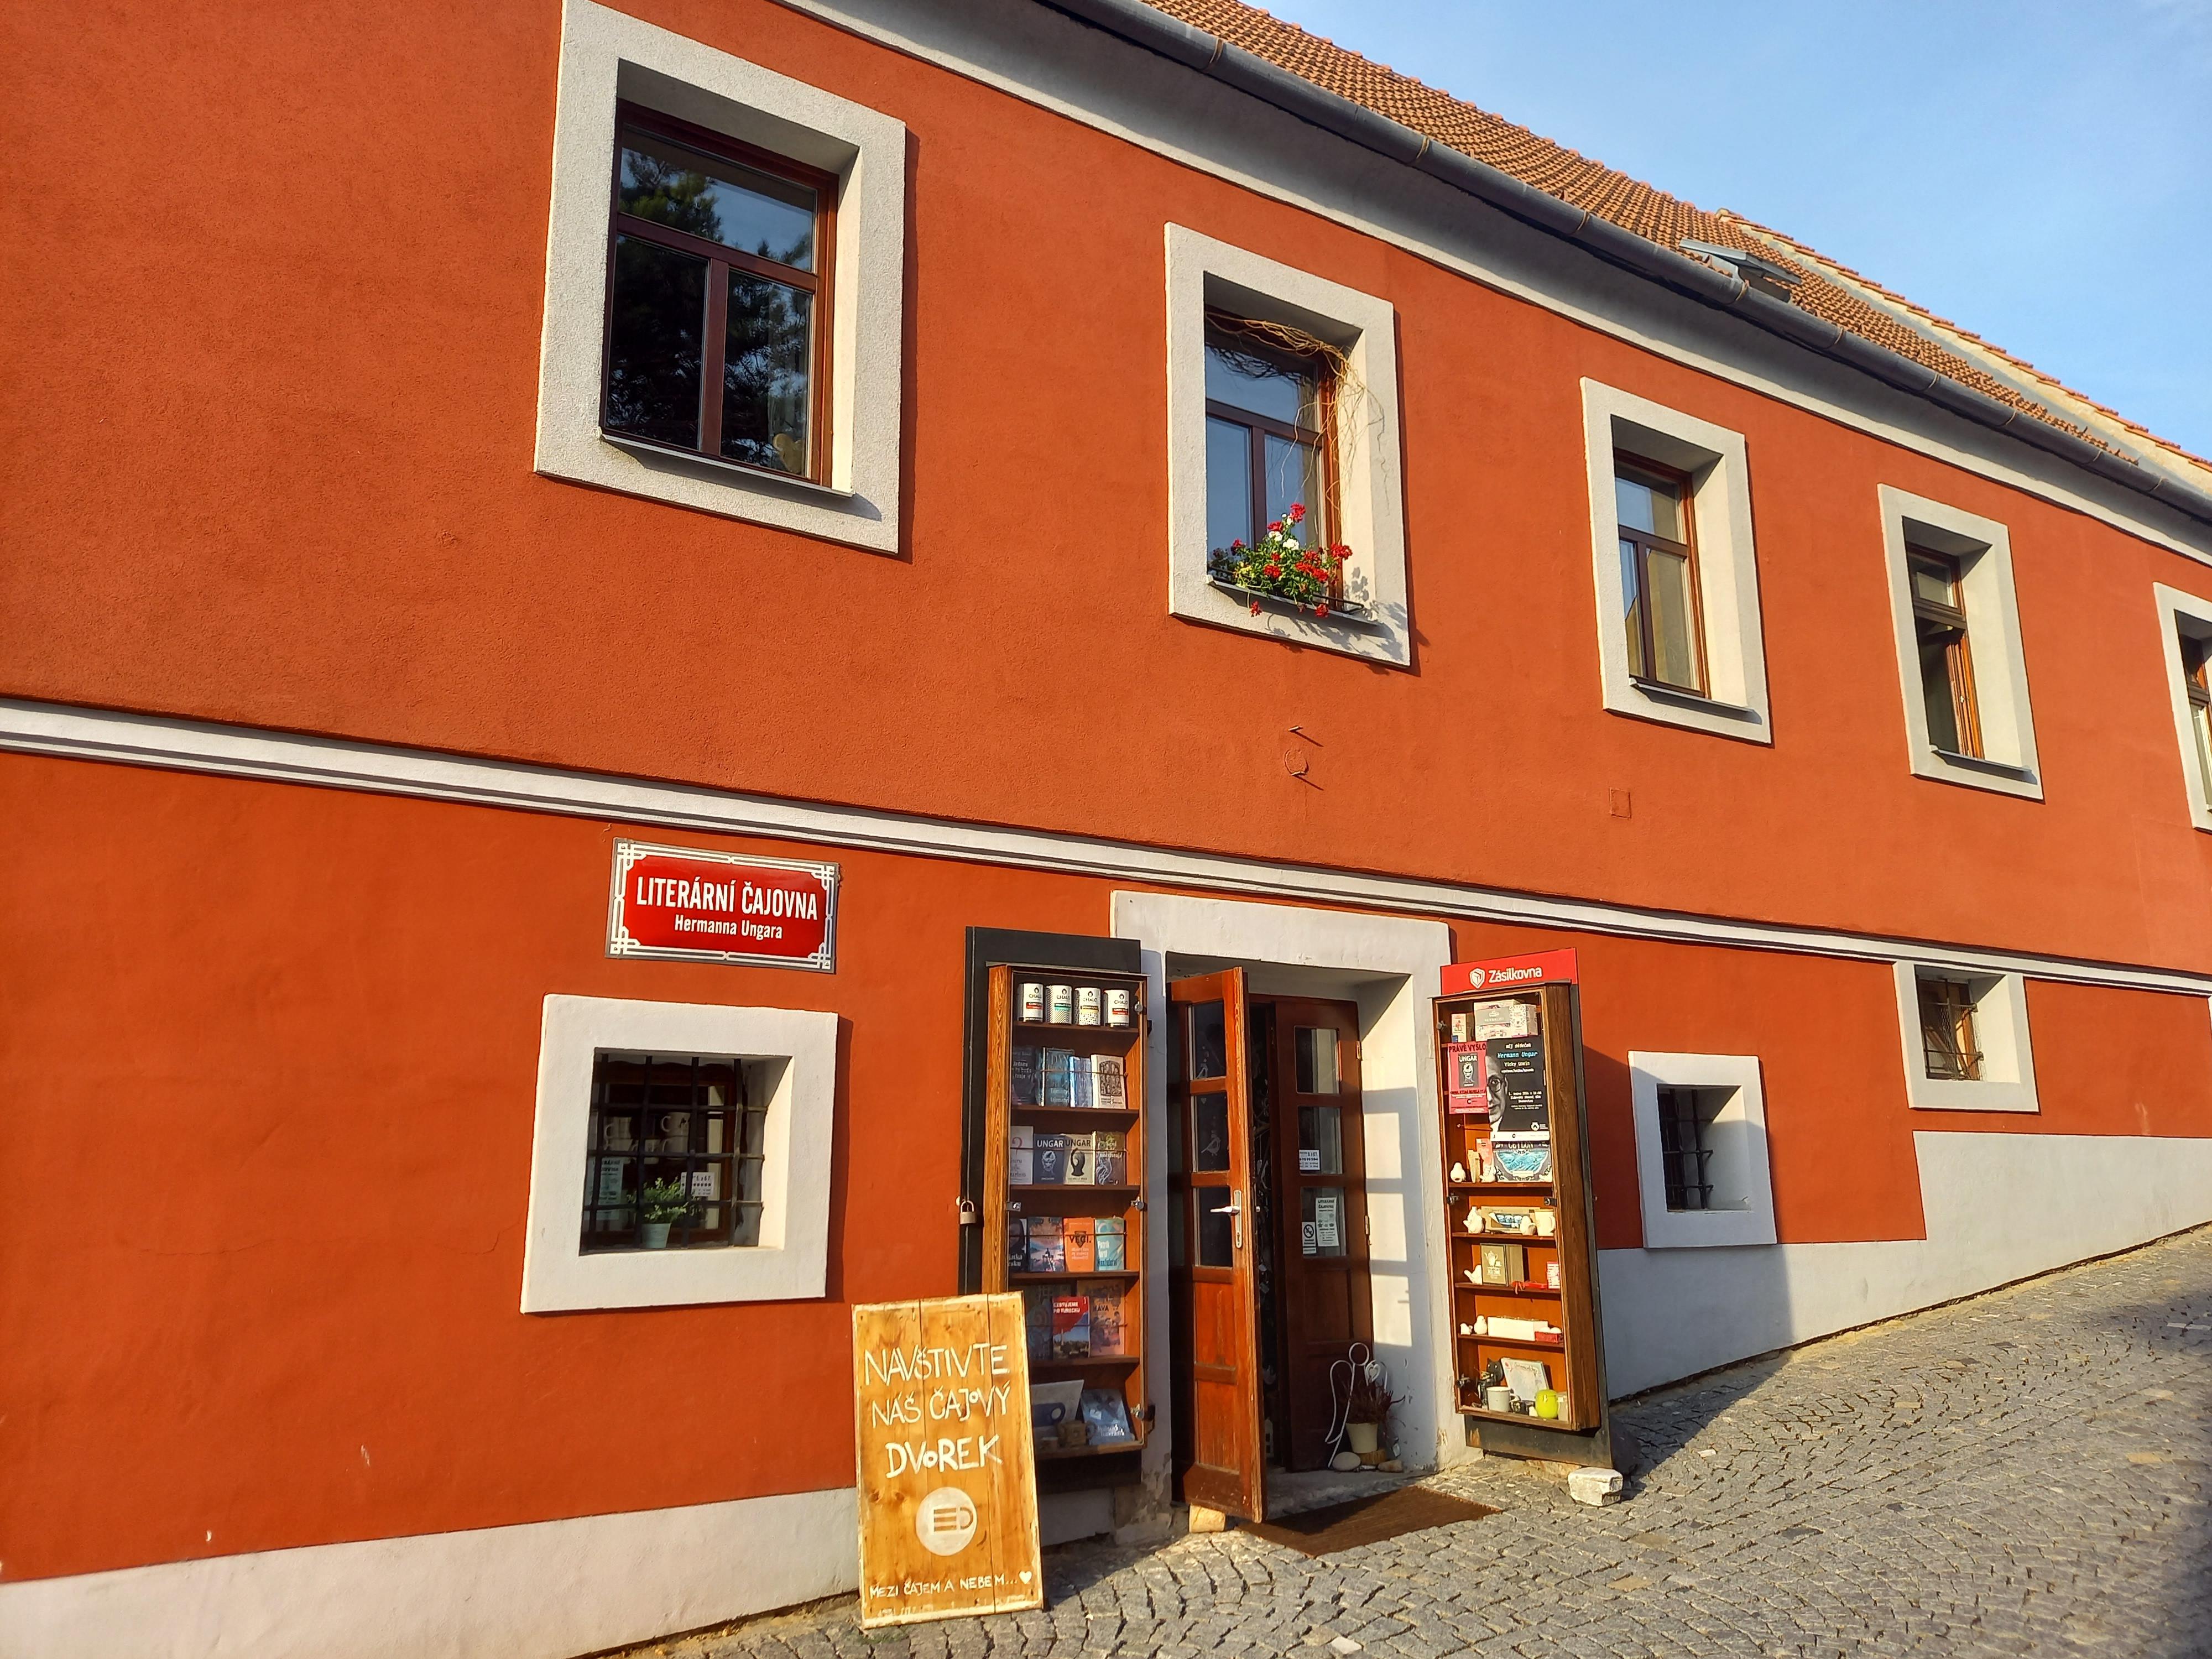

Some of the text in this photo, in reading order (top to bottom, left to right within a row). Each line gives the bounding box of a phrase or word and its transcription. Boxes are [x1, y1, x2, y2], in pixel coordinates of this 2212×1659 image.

[636, 876, 818, 920] LITERÁRNÍ ČAJOVNA
[675, 914, 783, 940] Hermanna Ungara
[1488, 967, 1543, 983] Zásilkovna
[1036, 1139, 1063, 1148] UNGAR
[1065, 1139, 1091, 1147] UNGAR
[864, 1343, 1010, 1386] NAVŠTIVTE
[872, 1380, 1011, 1428] NÁŠ ČAJOVÝ
[885, 1434, 1004, 1479] DVOREK
[869, 1585, 899, 1600] MEZI
[903, 1577, 941, 1596] ČAJEM
[943, 1580, 955, 1593] A
